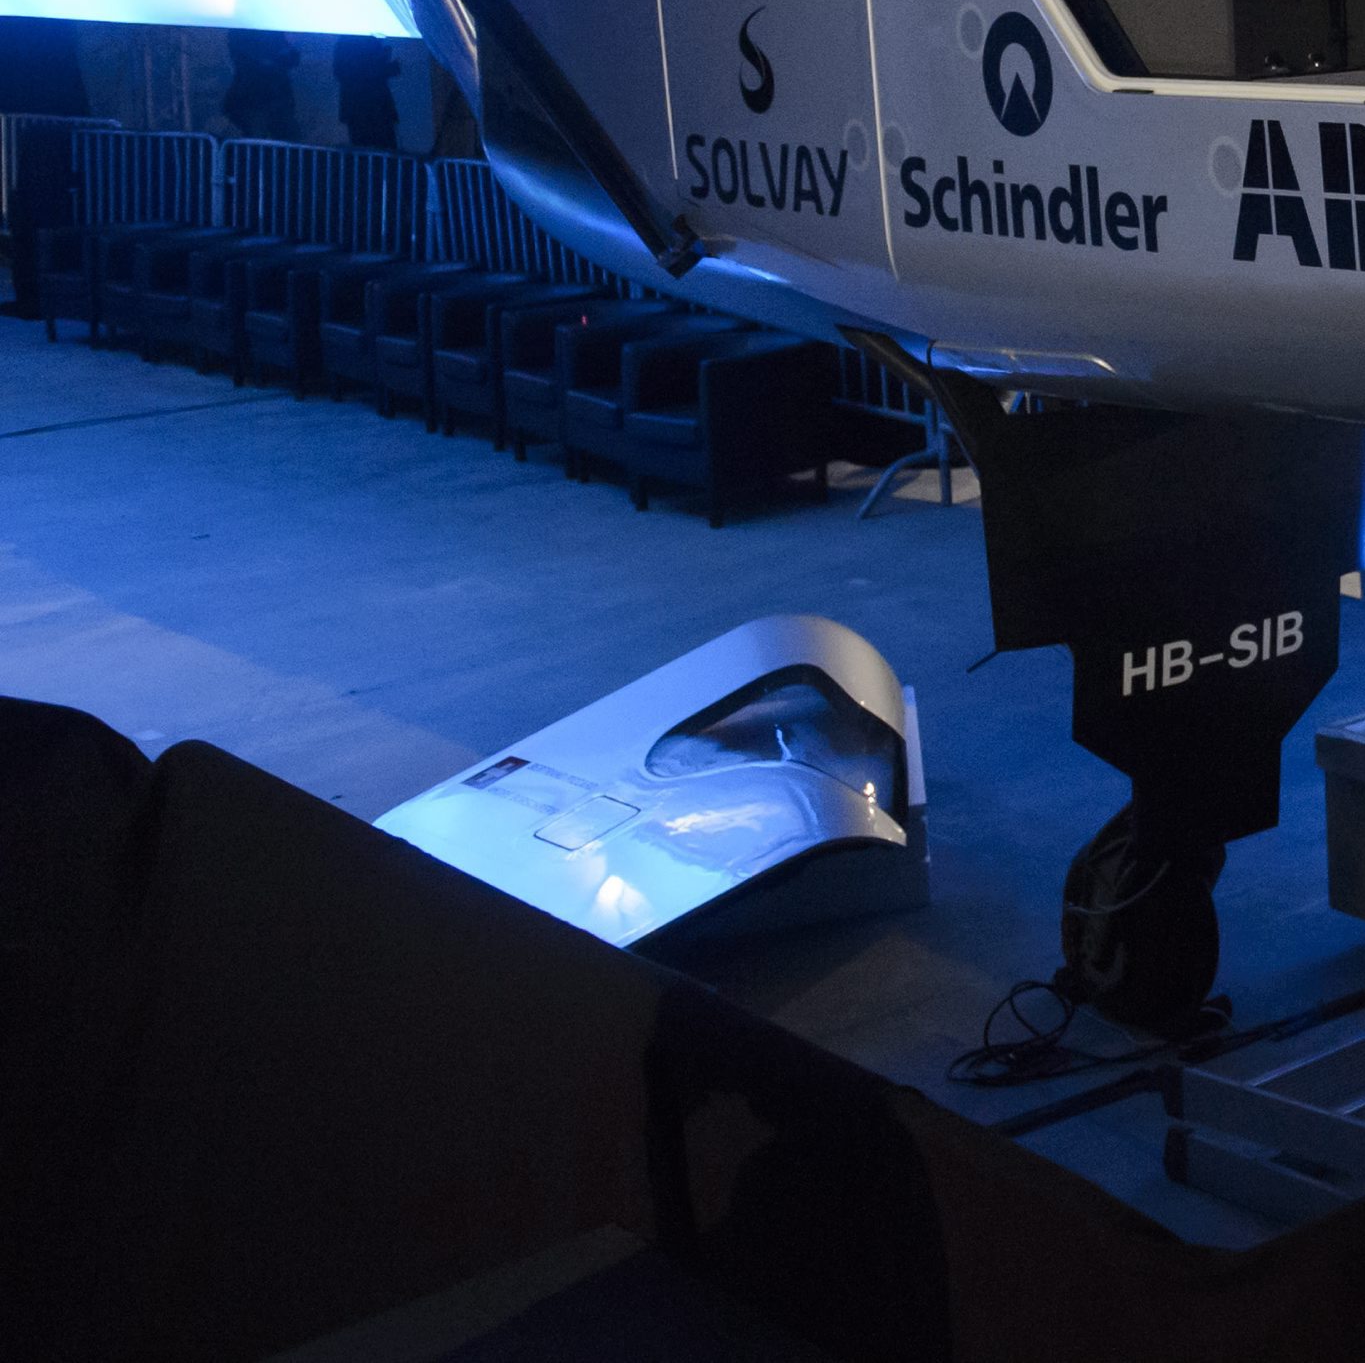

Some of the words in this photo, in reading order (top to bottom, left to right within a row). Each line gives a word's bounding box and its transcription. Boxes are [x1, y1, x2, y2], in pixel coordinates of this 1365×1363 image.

[686, 134, 848, 217] SOLVAY
[901, 156, 1168, 253] Schindler
[1122, 610, 1304, 697] HB-SIB
